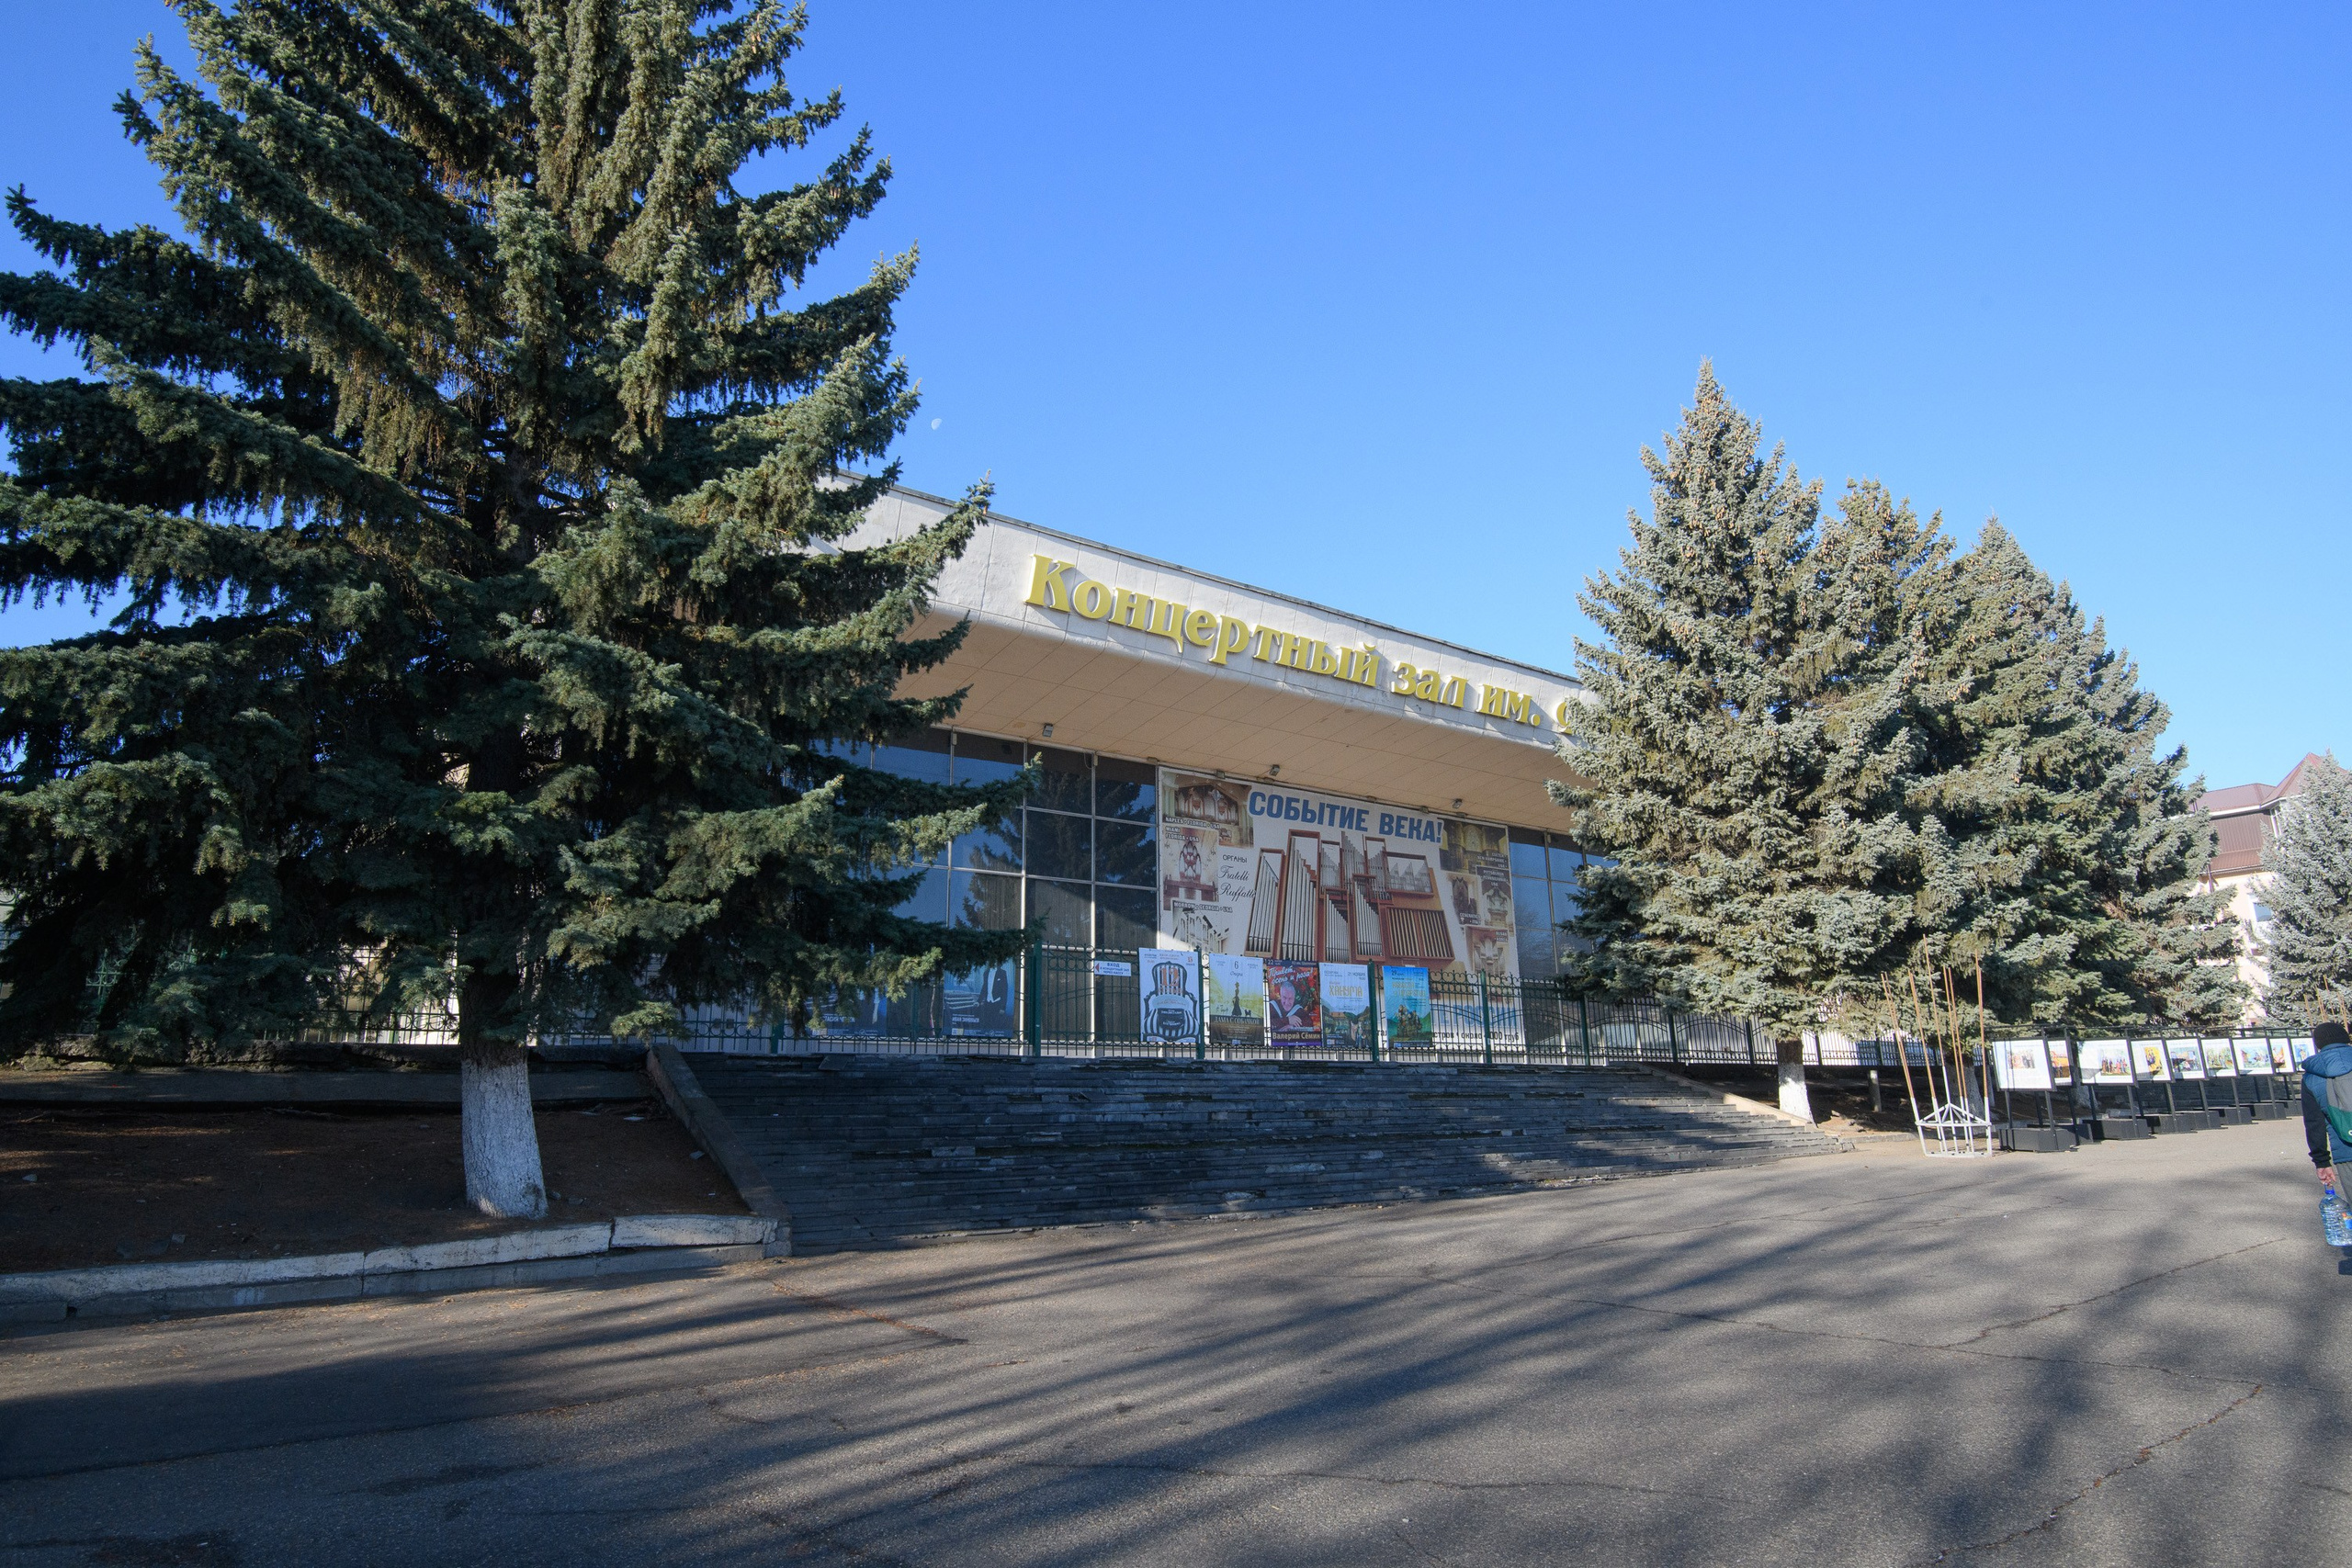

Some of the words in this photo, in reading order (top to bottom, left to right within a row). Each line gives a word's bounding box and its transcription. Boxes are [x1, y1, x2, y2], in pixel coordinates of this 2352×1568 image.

[1024, 554, 1380, 687] Концертный
[1391, 661, 1468, 708] зал
[1476, 683, 1541, 727] им.
[1165, 817, 1183, 825] NAPLES
[1187, 819, 1207, 828] FLORIDA
[1210, 821, 1221, 829] USA
[1249, 791, 1369, 832] СОБЫТИЕ
[1379, 812, 1442, 843] ВЕКА!
[1165, 832, 1185, 840] FLORIDA
[1222, 854, 1248, 863] ОРГАНЫ
[1216, 864, 1250, 882] Fratelli
[1234, 961, 1238, 969] 6
[1159, 966, 1179, 987] 12
[1329, 985, 1363, 997] ХАНУМА
[1272, 1032, 1300, 1041] Валерий
[1432, 1032, 1454, 1041] стров
[1484, 1031, 1503, 1040] 000
